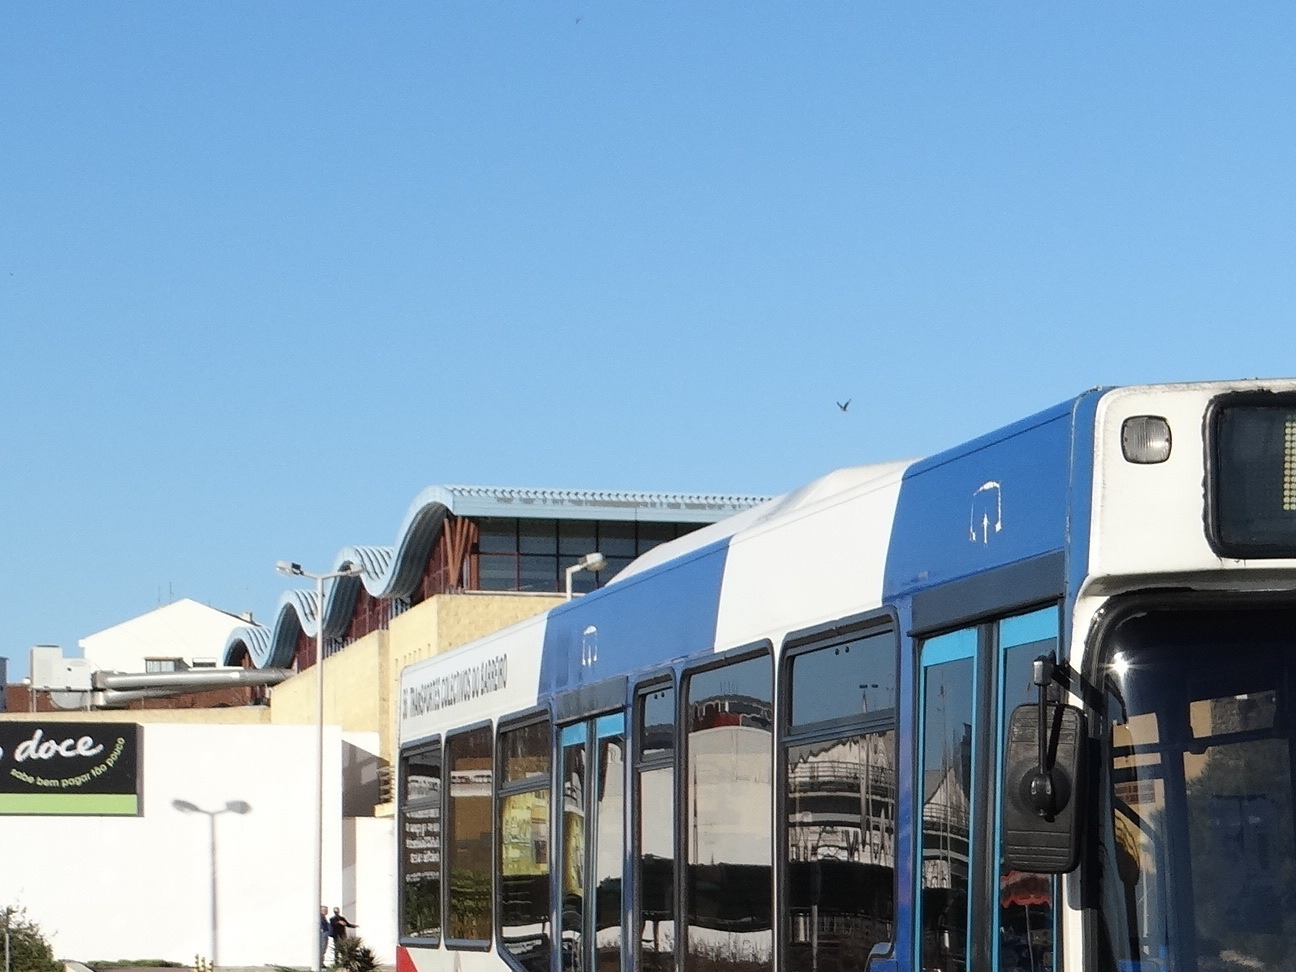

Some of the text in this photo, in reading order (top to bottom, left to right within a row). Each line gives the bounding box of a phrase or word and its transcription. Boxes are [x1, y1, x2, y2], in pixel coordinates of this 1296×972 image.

[10, 768, 35, 784] sabe
[36, 775, 59, 787] bem
[60, 773, 91, 789] pagar
[107, 737, 126, 767] pouco
[14, 728, 104, 763] doce
